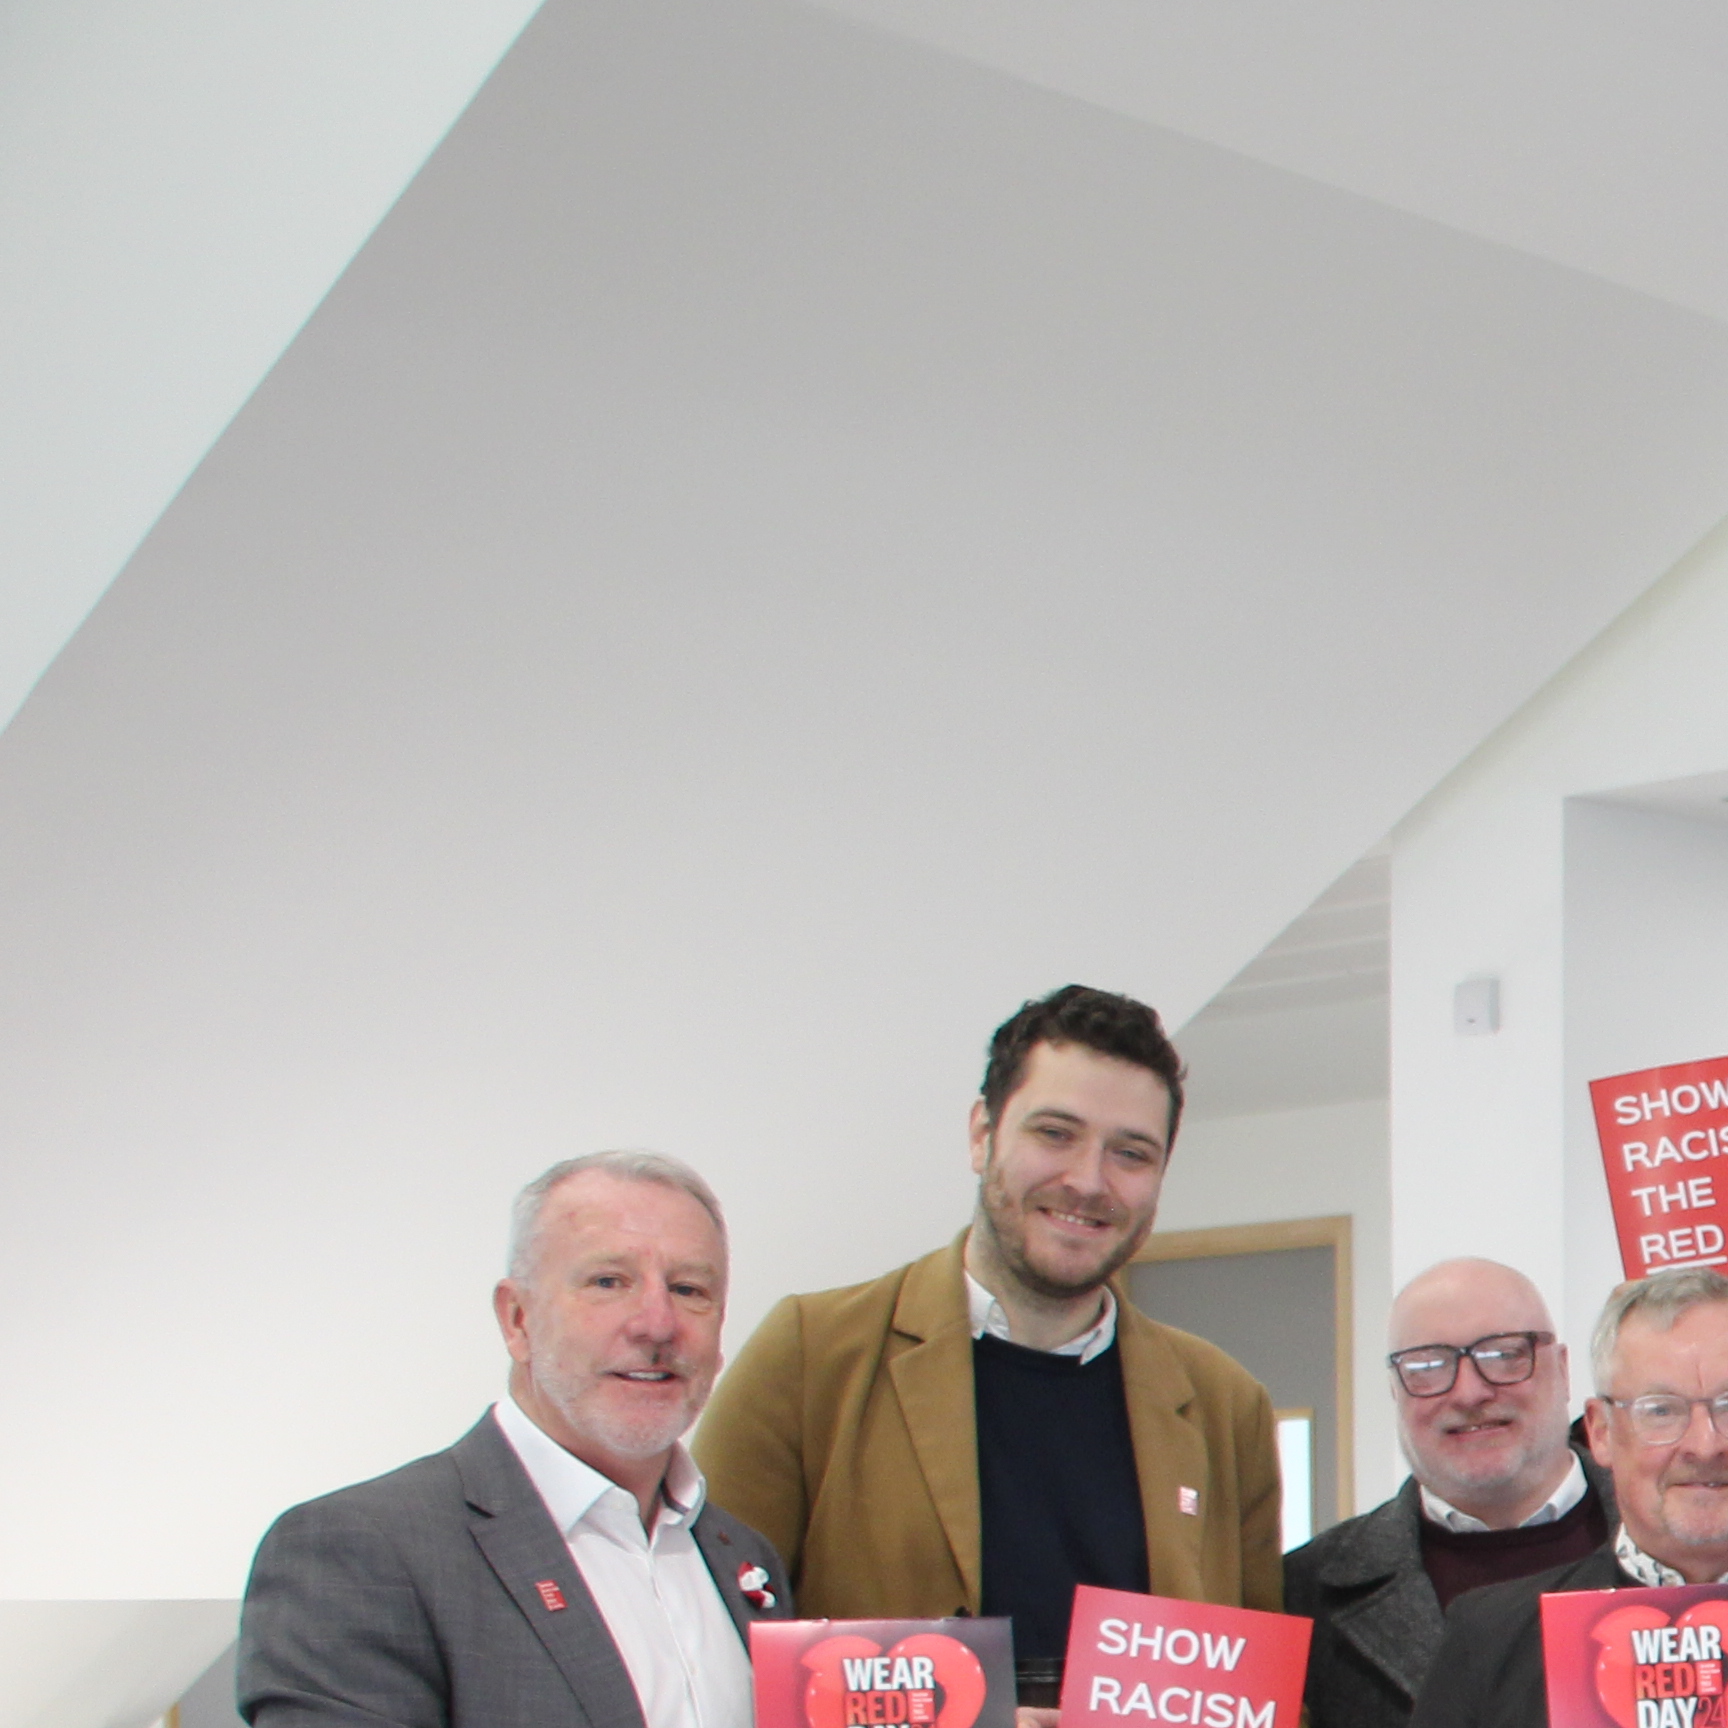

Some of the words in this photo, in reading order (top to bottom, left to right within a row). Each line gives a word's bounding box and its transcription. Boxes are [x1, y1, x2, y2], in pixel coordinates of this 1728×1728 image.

[1631, 1177, 1717, 1217] THE
[1640, 1224, 1725, 1264] RED
[1097, 1617, 1246, 1673] SHOW
[1632, 1625, 1722, 1664] WEAR
[843, 1656, 935, 1691] WEAR
[1635, 1663, 1696, 1700] RED
[846, 1691, 907, 1725] RED
